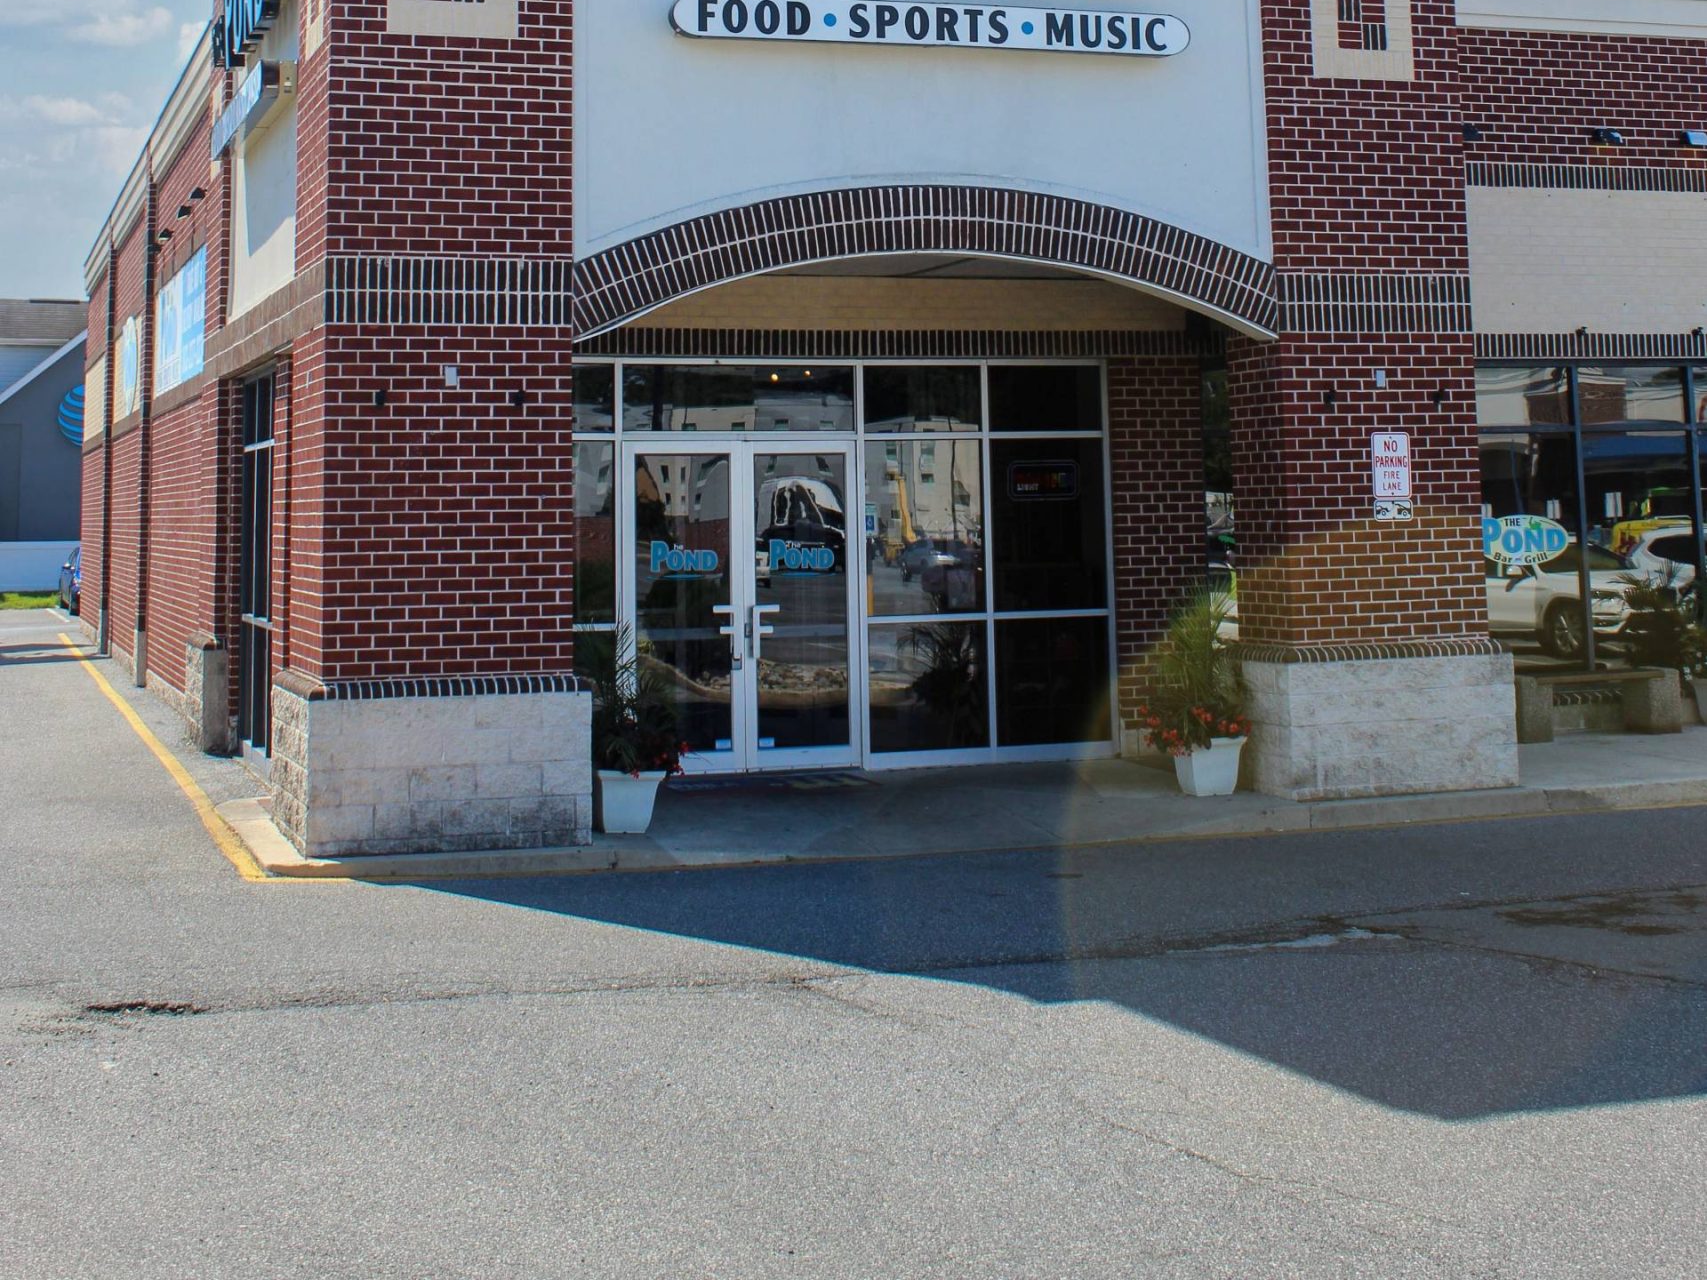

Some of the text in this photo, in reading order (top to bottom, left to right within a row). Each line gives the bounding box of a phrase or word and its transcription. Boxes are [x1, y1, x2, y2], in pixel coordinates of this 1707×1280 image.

[848, 3, 1009, 45] SPORTS
[1045, 12, 1168, 52] MUSIC
[1383, 440, 1398, 452] NO
[1375, 455, 1408, 468] PARKING
[1383, 470, 1400, 480] FIRE
[1382, 482, 1402, 491] LANE
[1503, 518, 1521, 527] THE
[1482, 517, 1567, 555] POND
[650, 540, 719, 573] POND
[769, 538, 835, 571] POND
[1493, 552, 1549, 564] Bar Grill
